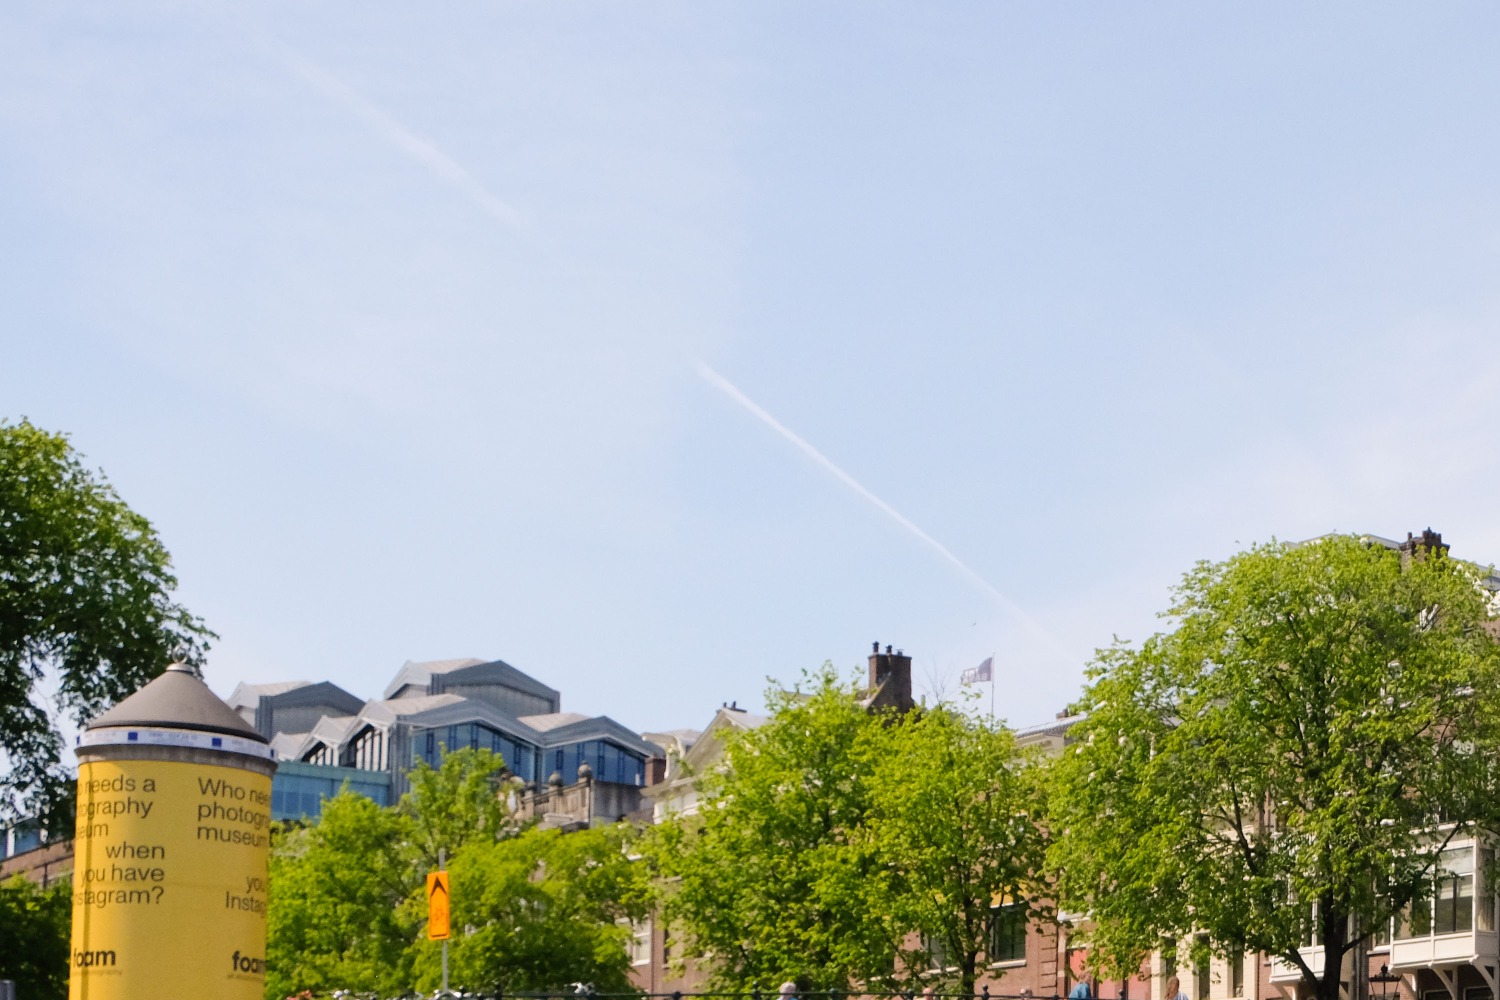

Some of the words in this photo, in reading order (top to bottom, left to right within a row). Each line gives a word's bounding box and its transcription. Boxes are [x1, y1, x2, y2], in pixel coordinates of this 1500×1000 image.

[85, 774, 136, 794] needs
[143, 778, 156, 793] a
[198, 777, 245, 800] Who
[106, 841, 166, 861] when
[80, 868, 105, 888] you
[111, 863, 165, 882] have
[73, 948, 116, 967] foam
